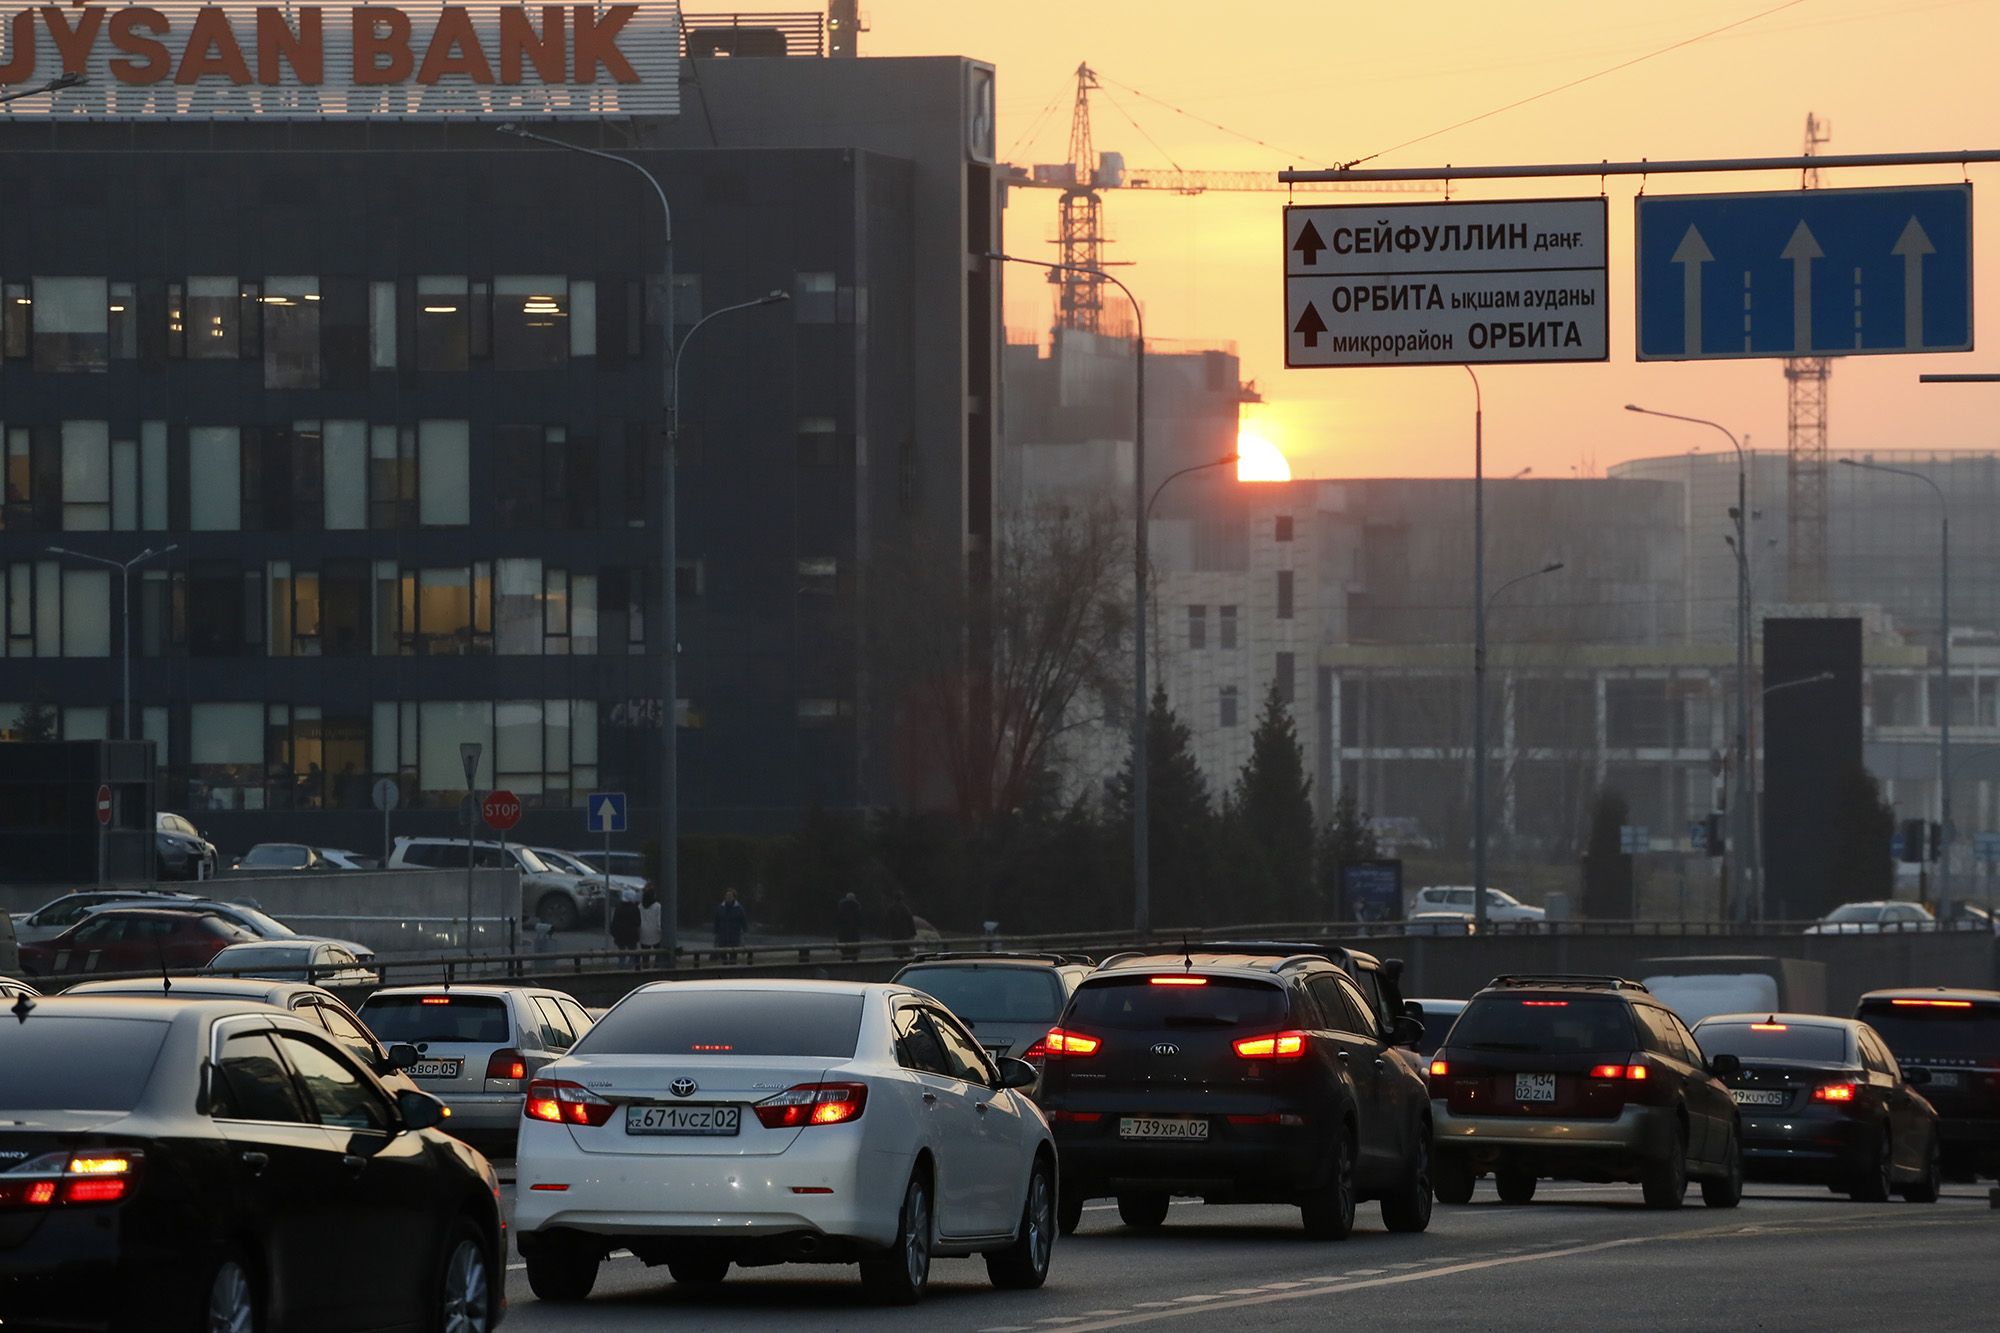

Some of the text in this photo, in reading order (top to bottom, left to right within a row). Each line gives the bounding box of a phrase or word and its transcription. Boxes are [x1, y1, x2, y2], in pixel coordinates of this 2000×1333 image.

[352, 6, 641, 84] BANK
[1333, 220, 1528, 254] СЕЙФУЛЛИН
[1332, 284, 1595, 313] ОРБИТА ықшам ауданы
[1334, 321, 1582, 356] микрорайон ОРБИТА
[485, 803, 519, 816] STOP
[1517, 1088, 1529, 1098] 02
[629, 1119, 641, 1127] KZ
[644, 1109, 737, 1128] 671VCZ 02
[1189, 1122, 1207, 1137] 02
